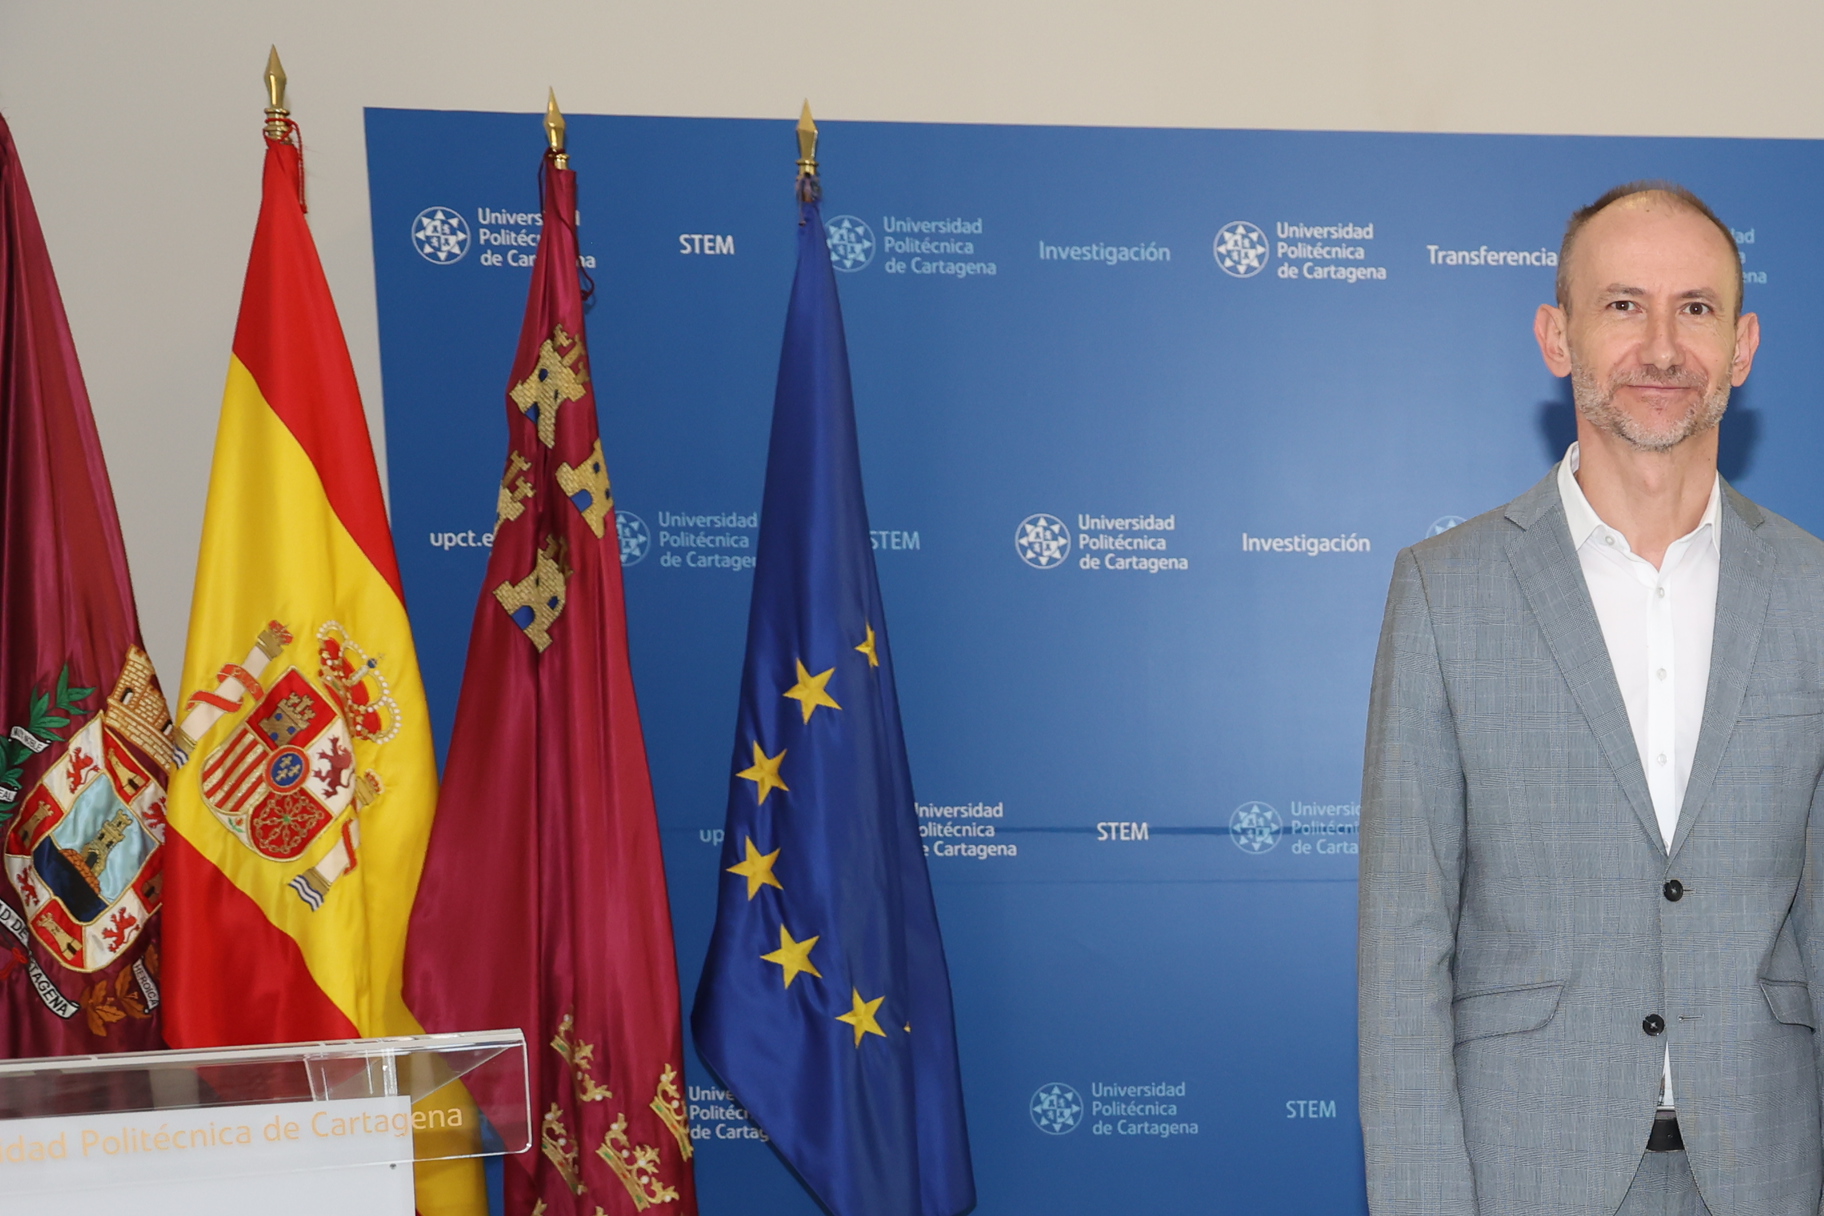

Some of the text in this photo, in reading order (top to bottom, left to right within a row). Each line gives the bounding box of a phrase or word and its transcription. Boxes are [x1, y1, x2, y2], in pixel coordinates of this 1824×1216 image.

[884, 217, 982, 236] Universidad
[1277, 222, 1373, 239] Universidad
[479, 228, 541, 247] Politéc
[680, 234, 734, 254] STEM
[885, 236, 974, 254] Politécnica
[480, 249, 596, 268] de Carna
[1040, 241, 1170, 265] Investigación
[1278, 242, 1364, 259] Politécnica
[1427, 245, 1557, 266] Transferencia
[885, 257, 996, 278] de Cartagena
[1278, 262, 1386, 283] de Cartagena
[659, 512, 757, 528] Universidad
[1079, 514, 1175, 530] Universidad
[430, 530, 494, 551] upct.e
[660, 531, 749, 548] Politécnica
[1080, 534, 1166, 550] Politécnica
[1243, 533, 1370, 556] Investigación
[660, 551, 756, 571] de Cartage
[1080, 553, 1188, 573] de Cartagena
[914, 802, 1004, 818] niversidad
[1291, 801, 1361, 816] Universi
[918, 822, 996, 837] olitécnica
[1097, 822, 1148, 840] STEM
[1291, 820, 1360, 835] Politécni
[933, 841, 1018, 860] Cartagena
[1291, 839, 1359, 854] de Carta
[28, 962, 68, 1016] TAGENA
[1092, 1082, 1185, 1097] Universidad
[689, 1105, 749, 1121] Politéc
[1093, 1101, 1177, 1116] Politécnica
[1286, 1101, 1336, 1118] STEM
[81, 1123, 252, 1157] Politécnica
[263, 1116, 300, 1142] de
[311, 1107, 463, 1137] Cartagena
[691, 1123, 770, 1142] de Cartag
[1093, 1120, 1198, 1137] de Cartagena
